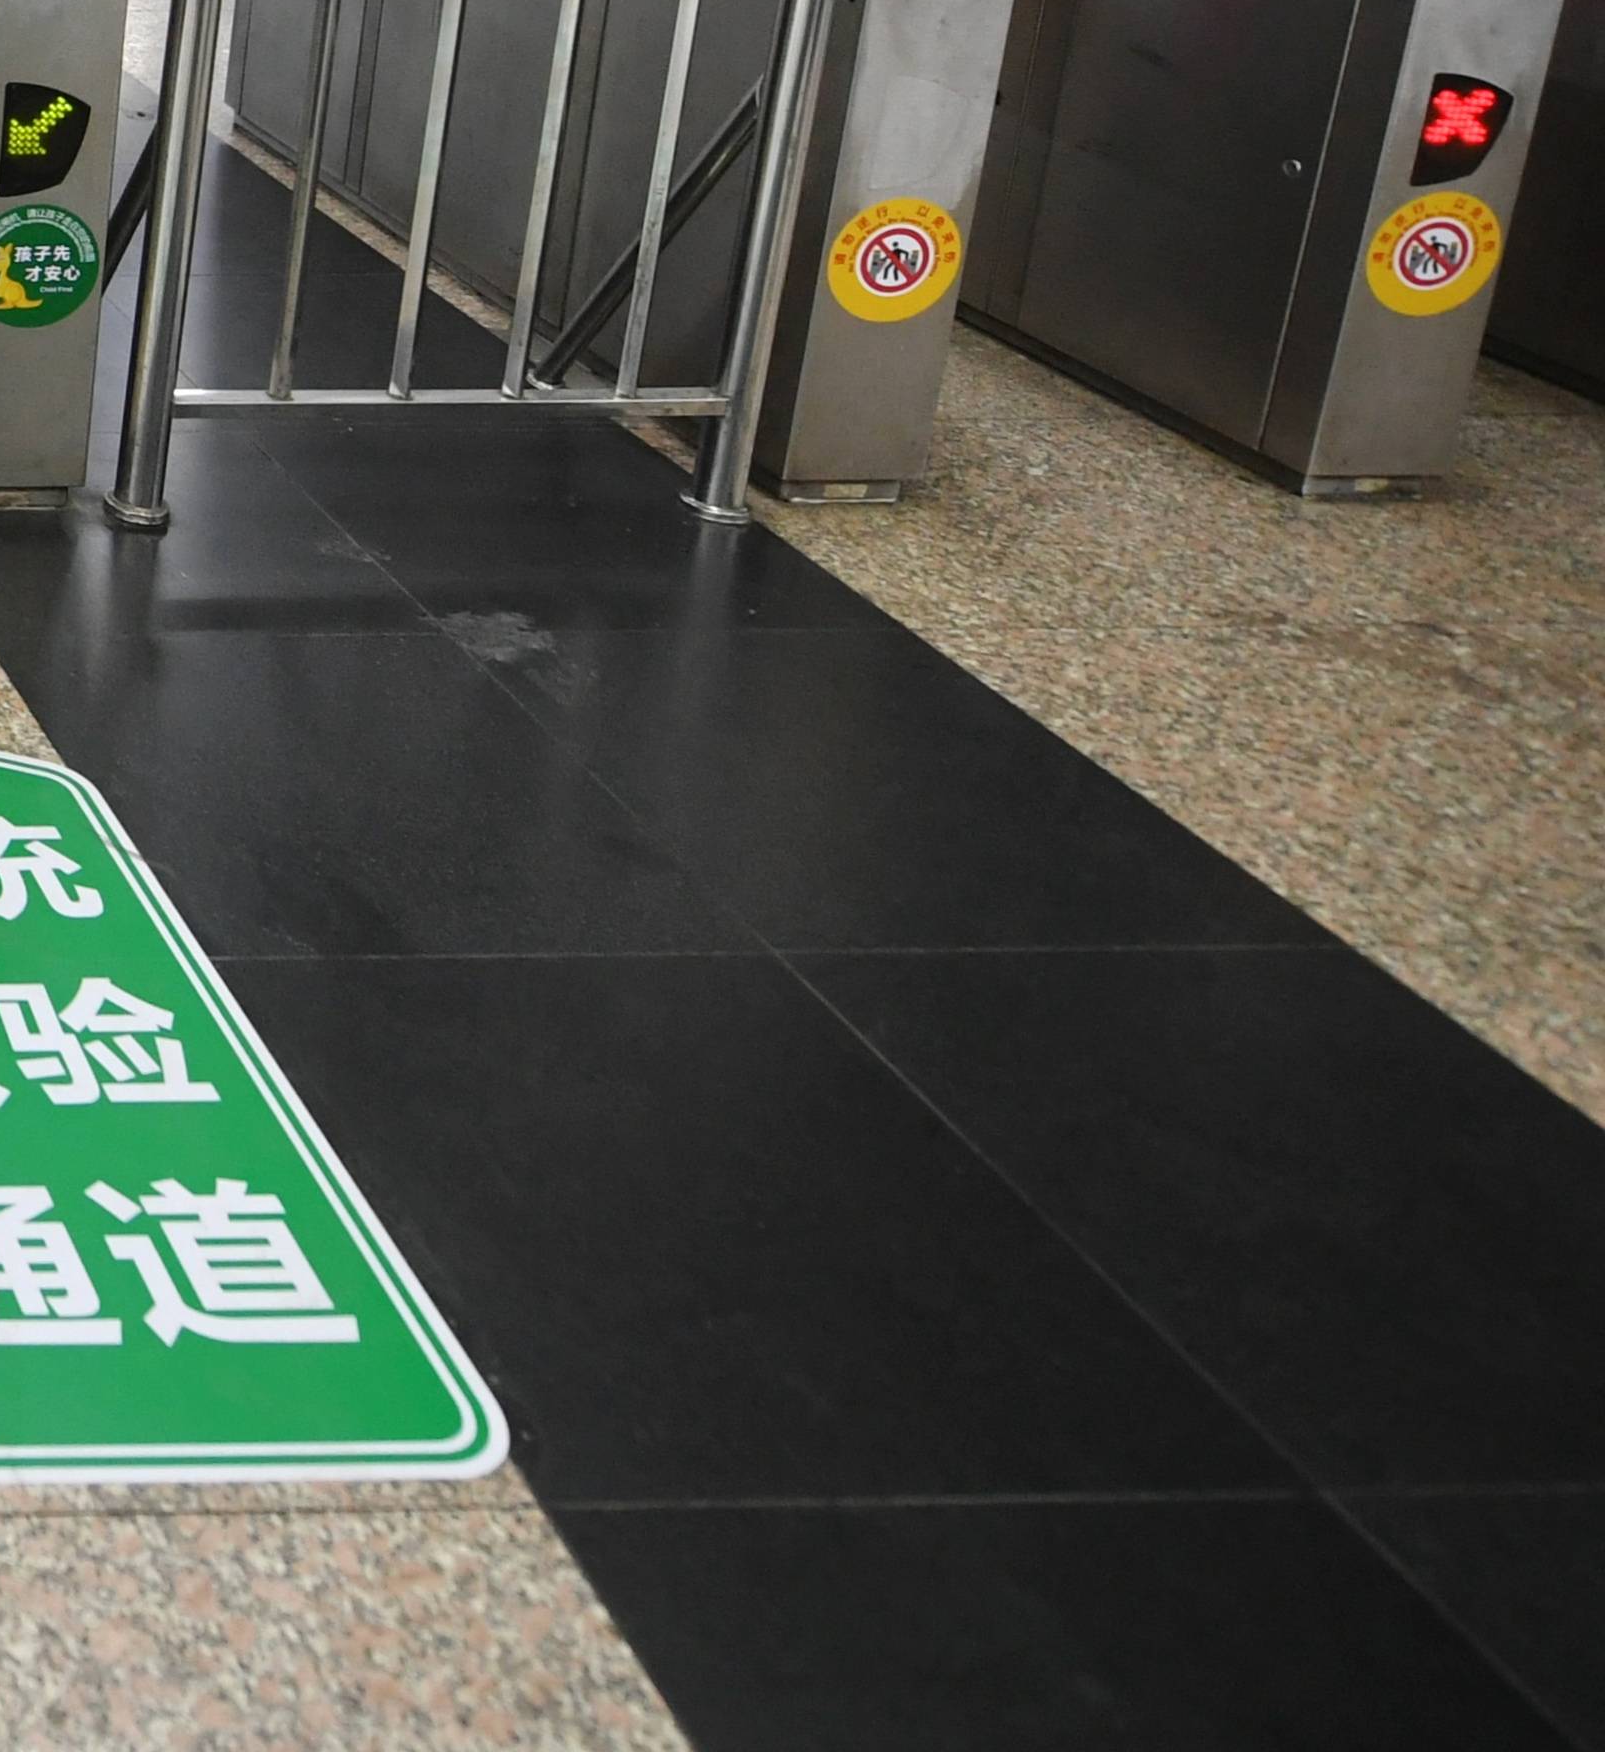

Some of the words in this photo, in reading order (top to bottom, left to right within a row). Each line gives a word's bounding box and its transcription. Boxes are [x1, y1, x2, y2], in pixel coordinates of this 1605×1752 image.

[14, 245, 70, 263] 孩子先
[24, 265, 81, 282] 才安心
